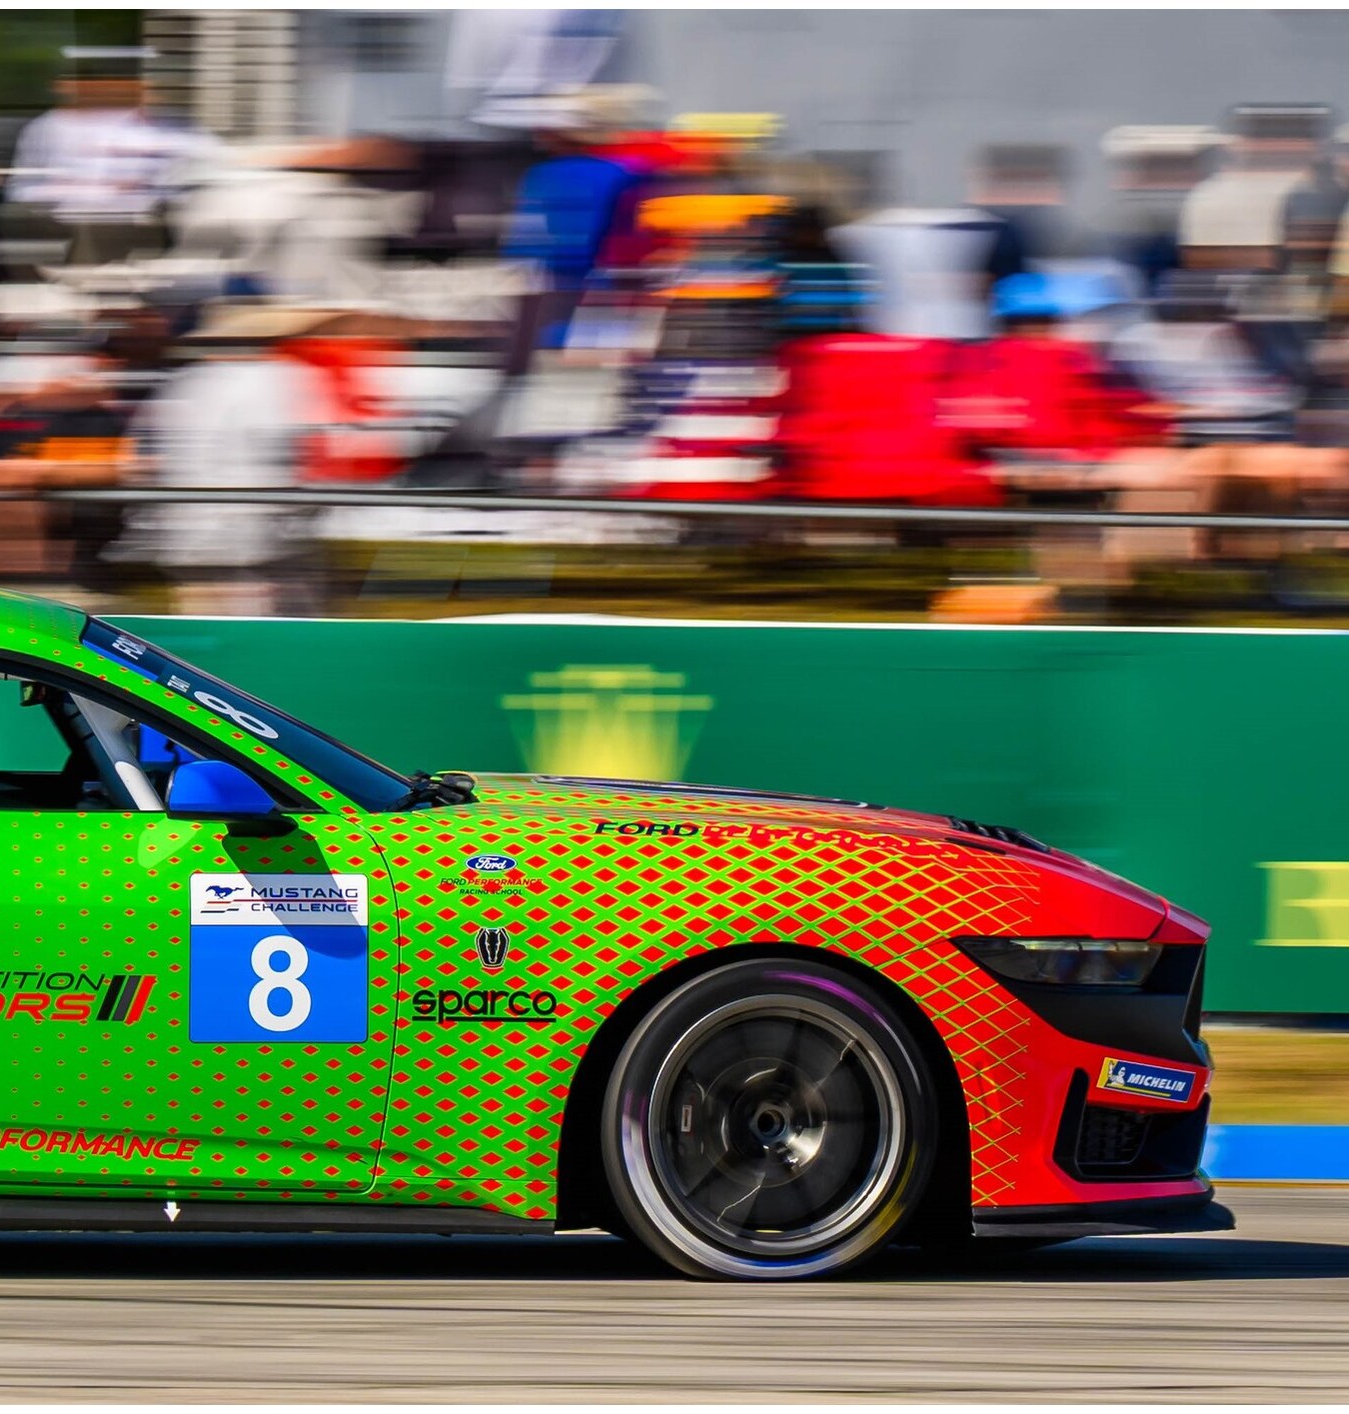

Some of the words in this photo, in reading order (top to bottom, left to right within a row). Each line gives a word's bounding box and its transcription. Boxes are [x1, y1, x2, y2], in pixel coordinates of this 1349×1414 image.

[194, 691, 279, 739] 8
[594, 822, 699, 836] FORD
[475, 857, 507, 869] Ford
[440, 878, 467, 886] FORD
[467, 878, 543, 886] PERFORMANCE
[251, 887, 359, 898] MUSTANG
[251, 903, 359, 912] CHALLENGE
[248, 935, 312, 1032] 8
[412, 990, 557, 1024] sparco
[1126, 1073, 1186, 1092] MICHELIN
